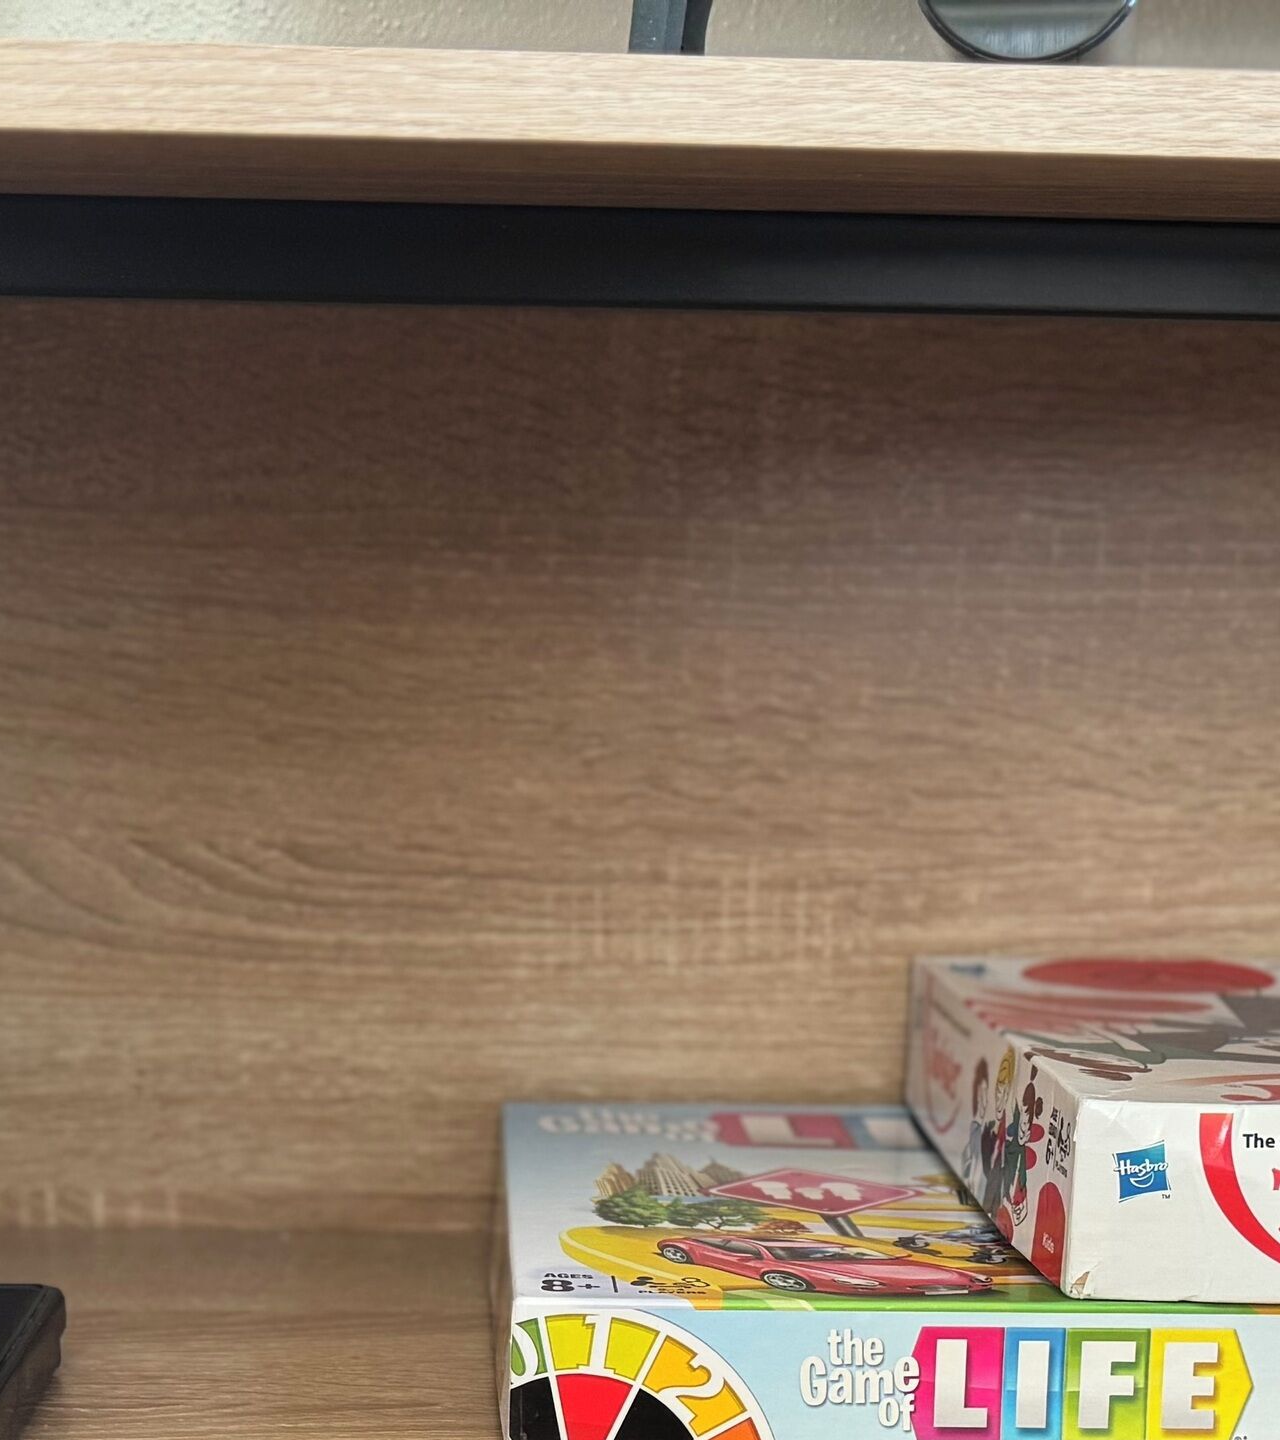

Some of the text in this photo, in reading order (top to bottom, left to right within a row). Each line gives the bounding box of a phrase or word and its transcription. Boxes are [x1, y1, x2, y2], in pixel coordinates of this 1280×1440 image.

[1242, 1133, 1276, 1149] The
[1113, 1159, 1169, 1176] Hasbro
[541, 1280, 600, 1291] 8+
[827, 1328, 885, 1366] the
[799, 1355, 920, 1407] Game
[933, 1338, 1219, 1430] LIFE
[878, 1393, 916, 1431] of
